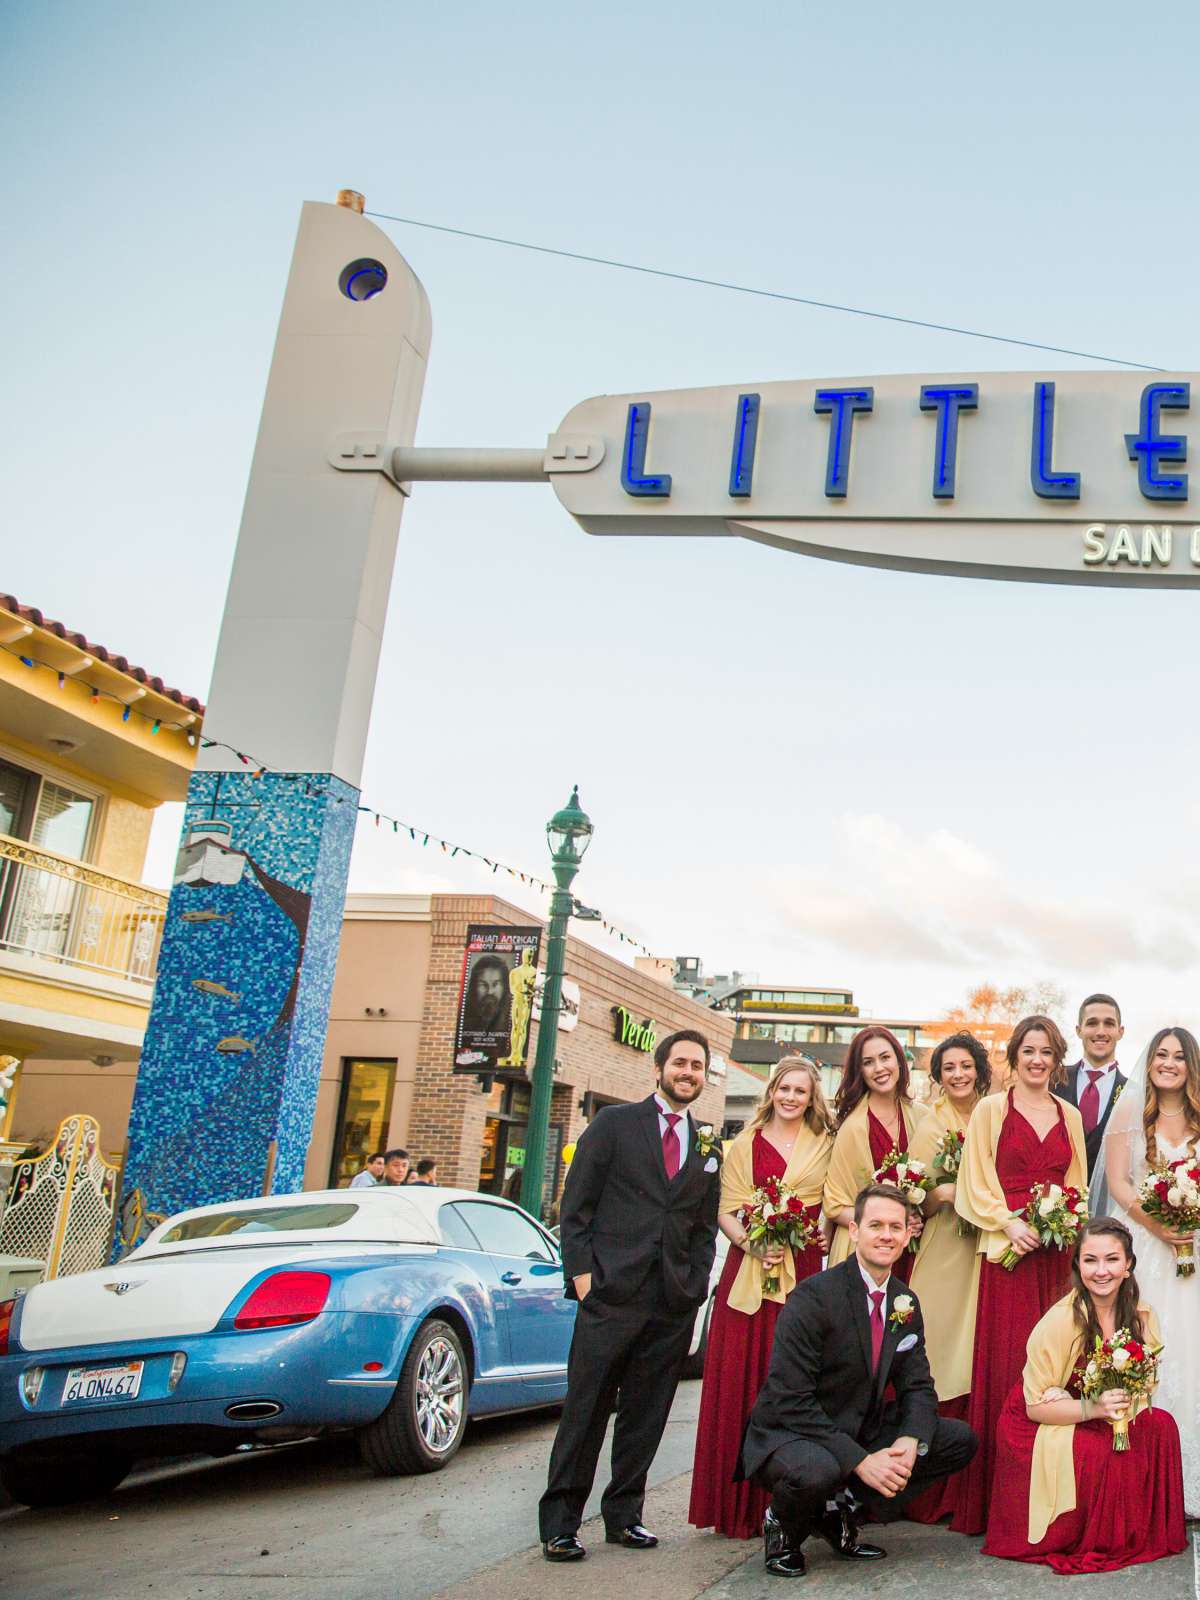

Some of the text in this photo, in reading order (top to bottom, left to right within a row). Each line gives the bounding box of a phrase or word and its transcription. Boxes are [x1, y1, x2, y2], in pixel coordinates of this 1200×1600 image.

[621, 381, 1190, 500] LITTLE
[1083, 523, 1172, 566] SAN
[470, 934, 538, 945] ITALIAN AMERICAN
[616, 1006, 657, 1052] Verde
